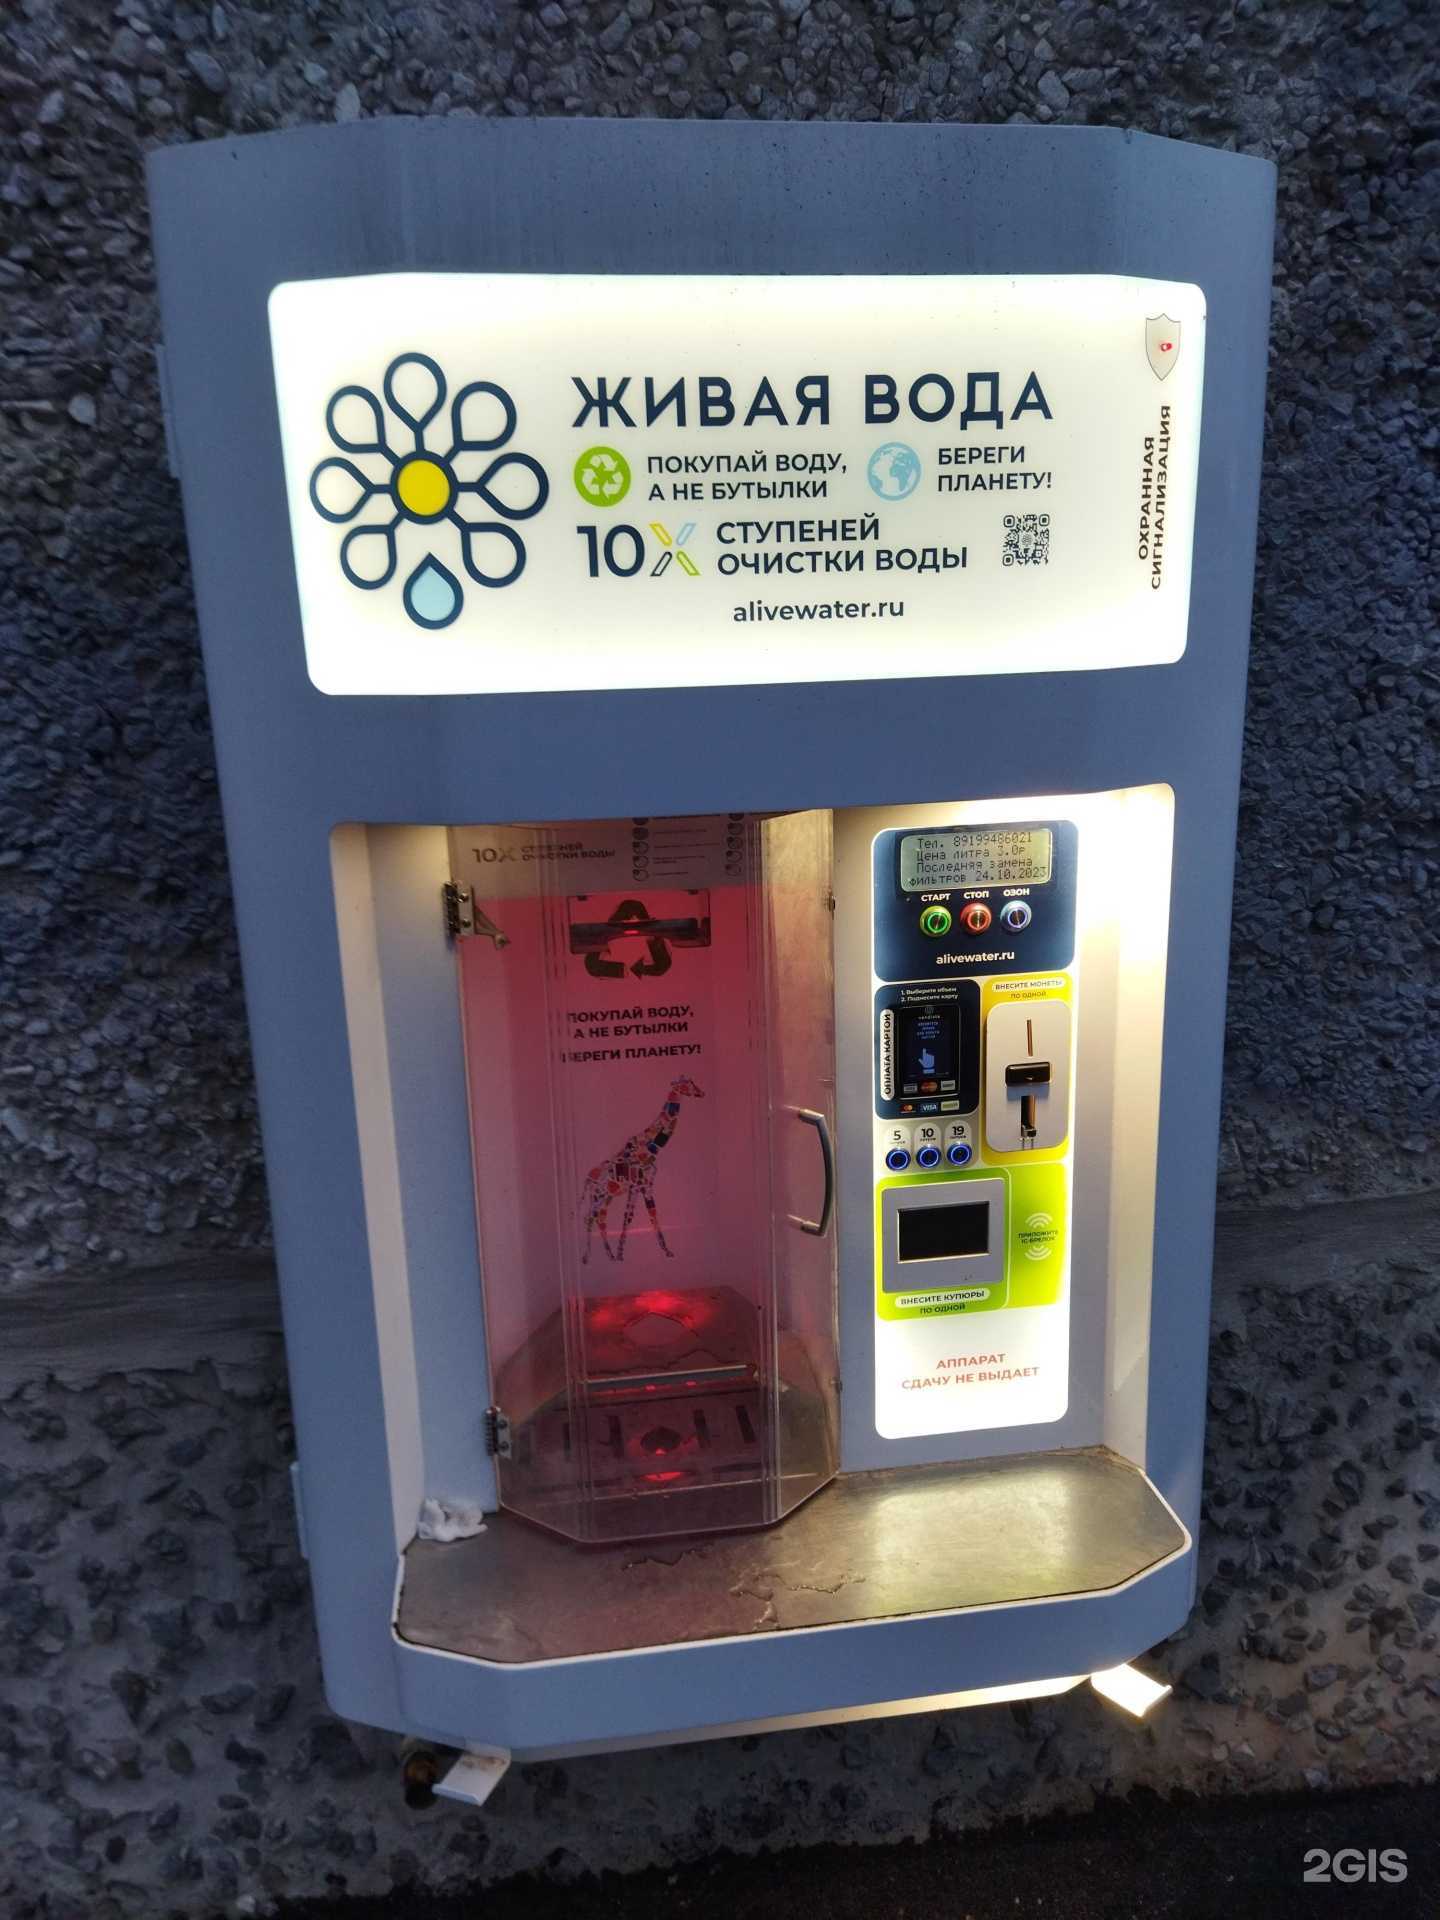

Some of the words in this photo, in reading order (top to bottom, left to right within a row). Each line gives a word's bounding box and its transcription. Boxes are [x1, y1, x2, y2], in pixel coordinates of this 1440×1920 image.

[570, 375, 830, 428] ЖИВАЯ
[864, 371, 1053, 431] ВОДА
[647, 450, 769, 474] ПОКУПАЙ
[775, 453, 848, 475] ВОДУ,
[938, 446, 1026, 466] БЕРЕГИ
[937, 472, 1052, 493] ПЛАНЕТУ!
[648, 483, 665, 501] А
[672, 482, 704, 500] НЕ
[711, 480, 828, 500] БУТЫЛКИ
[1151, 405, 1171, 590] СИГНАЛИЗАЦИЯ
[1138, 437, 1155, 560] ОХРАННАЯ
[716, 513, 880, 545] СТУПЕНЕЙ
[717, 551, 866, 576] ОЧИСТКИ
[875, 547, 968, 574] ВОДЫ
[732, 600, 905, 622] alivewater.ru
[917, 838, 944, 849] Тел.
[916, 851, 946, 862] Цена
[953, 849, 990, 860] литра
[916, 861, 983, 873] Последняя
[989, 858, 1033, 869] замена
[921, 893, 951, 902] СТАРТ
[963, 891, 990, 900] СТОП
[1003, 888, 1030, 897] ОЗОН
[936, 951, 1015, 965] alivewater.ru
[995, 982, 1028, 990] ВНЕСИТЕ
[1022, 991, 1046, 999] ОДНОЙ
[567, 1006, 643, 1023] ПОКУПАЙ
[648, 1005, 694, 1018] ВОДУ,
[574, 1029, 585, 1039] А
[590, 1027, 609, 1038] НЕ
[614, 1022, 688, 1036] БУТЫЛКИ
[625, 1044, 701, 1059] ПЛАНЕТУ!
[893, 1131, 901, 1140] 5
[921, 1128, 934, 1138] 10
[952, 1126, 964, 1136] 19
[901, 1294, 942, 1305] ВНЕСИТЕ
[943, 1290, 985, 1301] КУПЮРЫ
[920, 1307, 933, 1315] ПО
[934, 1303, 966, 1314] ОДНОЙ
[936, 1353, 1006, 1369] АППАРАТ
[902, 1375, 951, 1390] СДАЧУ
[955, 1373, 975, 1384] НЕ
[978, 1367, 1040, 1382] ВЫДАЕТ
